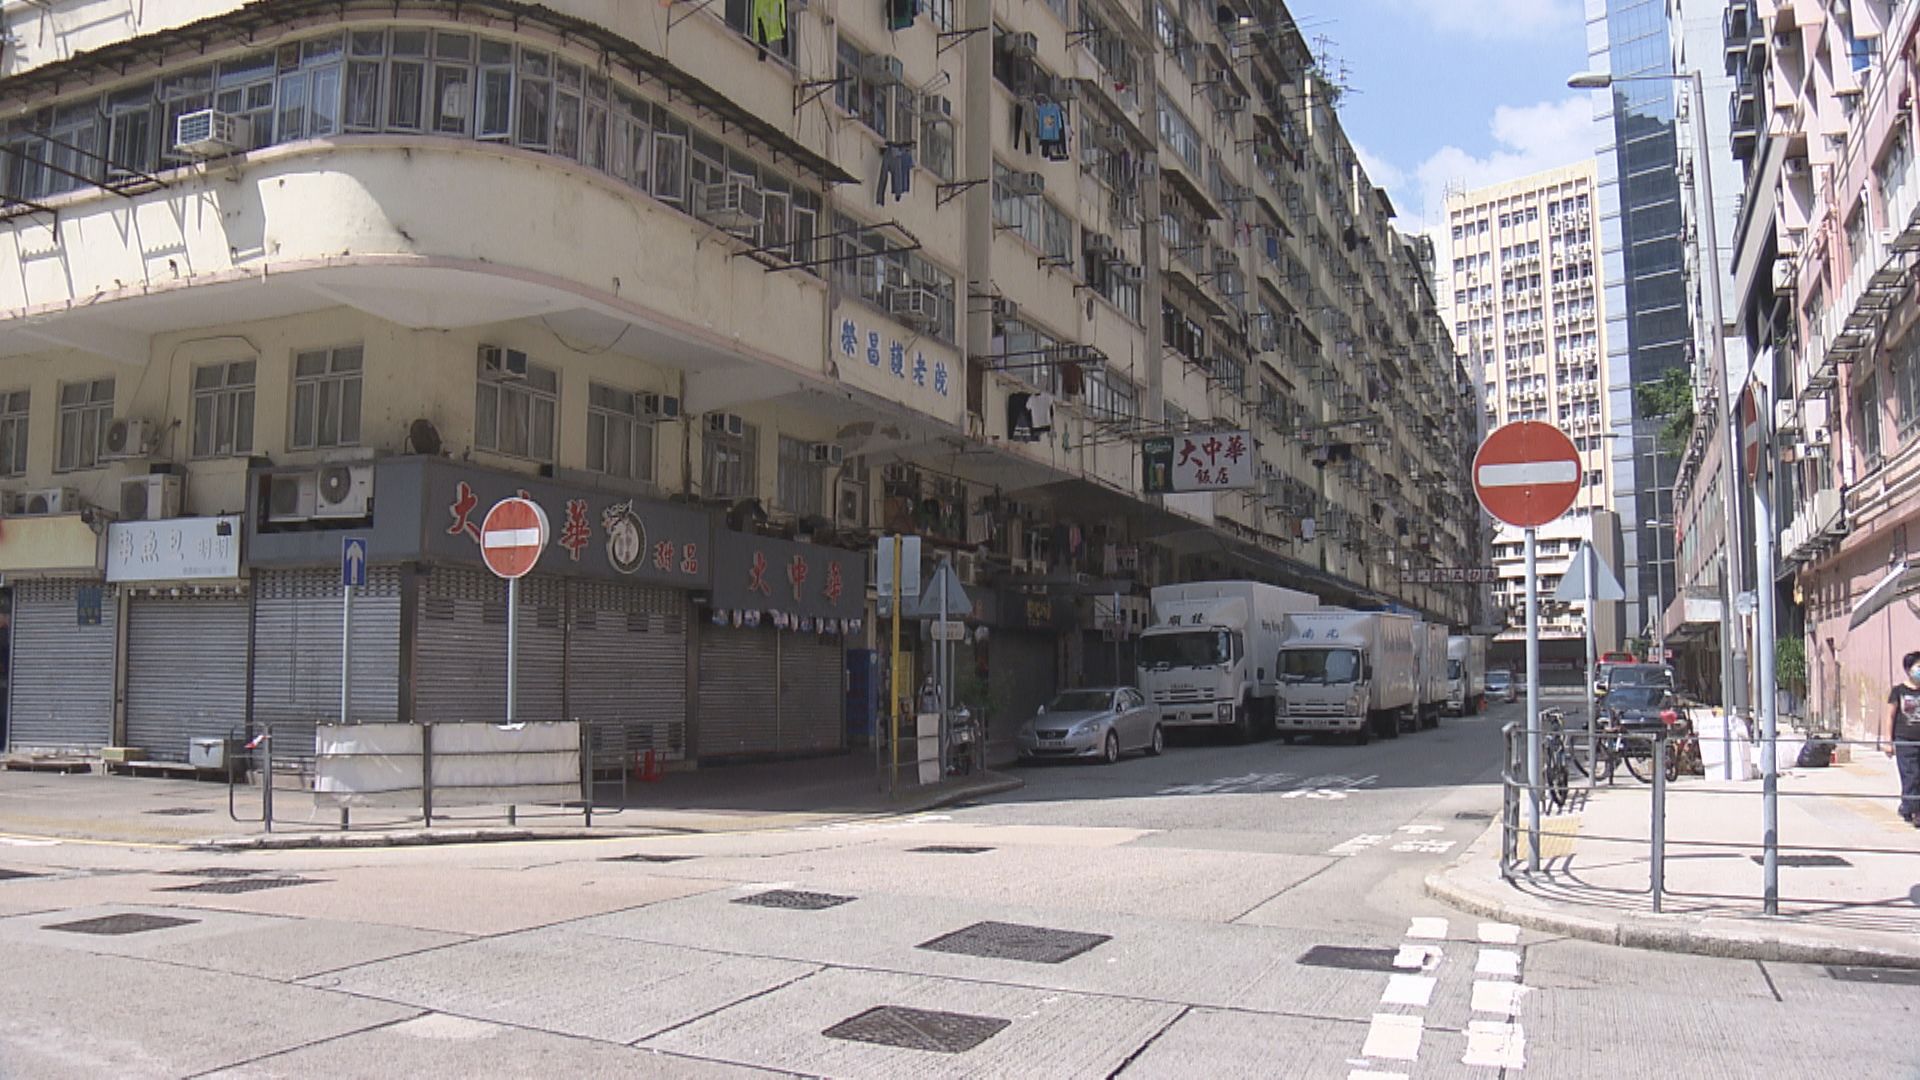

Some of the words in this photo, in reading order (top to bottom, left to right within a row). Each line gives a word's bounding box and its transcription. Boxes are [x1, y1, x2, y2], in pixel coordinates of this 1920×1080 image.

[842, 319, 947, 396] 榮昌護老院
[1177, 435, 1247, 467] 大中華
[1195, 467, 1229, 484] 飯店
[447, 481, 591, 561] 大華
[749, 551, 843, 607] 大中華
